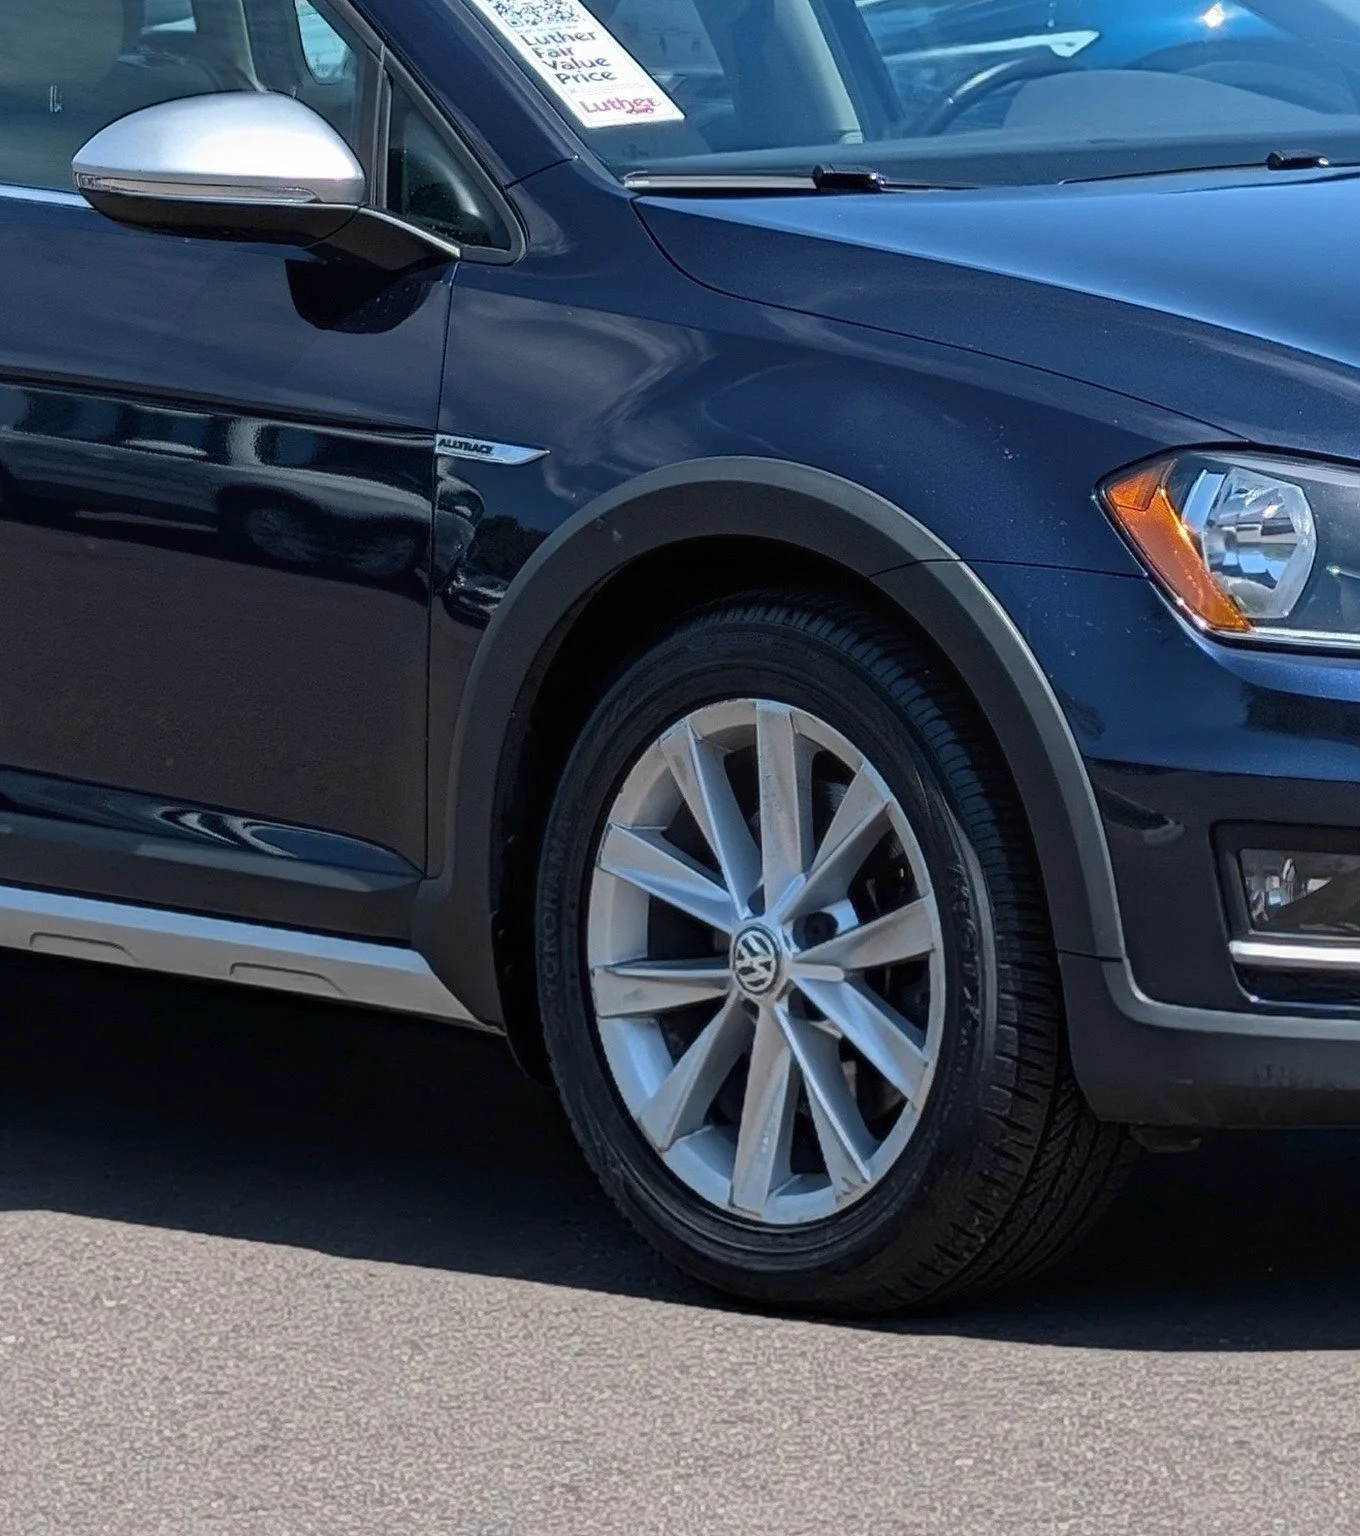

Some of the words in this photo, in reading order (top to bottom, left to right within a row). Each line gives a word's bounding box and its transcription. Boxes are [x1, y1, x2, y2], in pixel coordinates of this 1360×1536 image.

[519, 31, 597, 46] Luther
[531, 44, 574, 58] Fair
[541, 57, 611, 70] Value
[554, 69, 618, 84] Price
[578, 96, 656, 113] Luther
